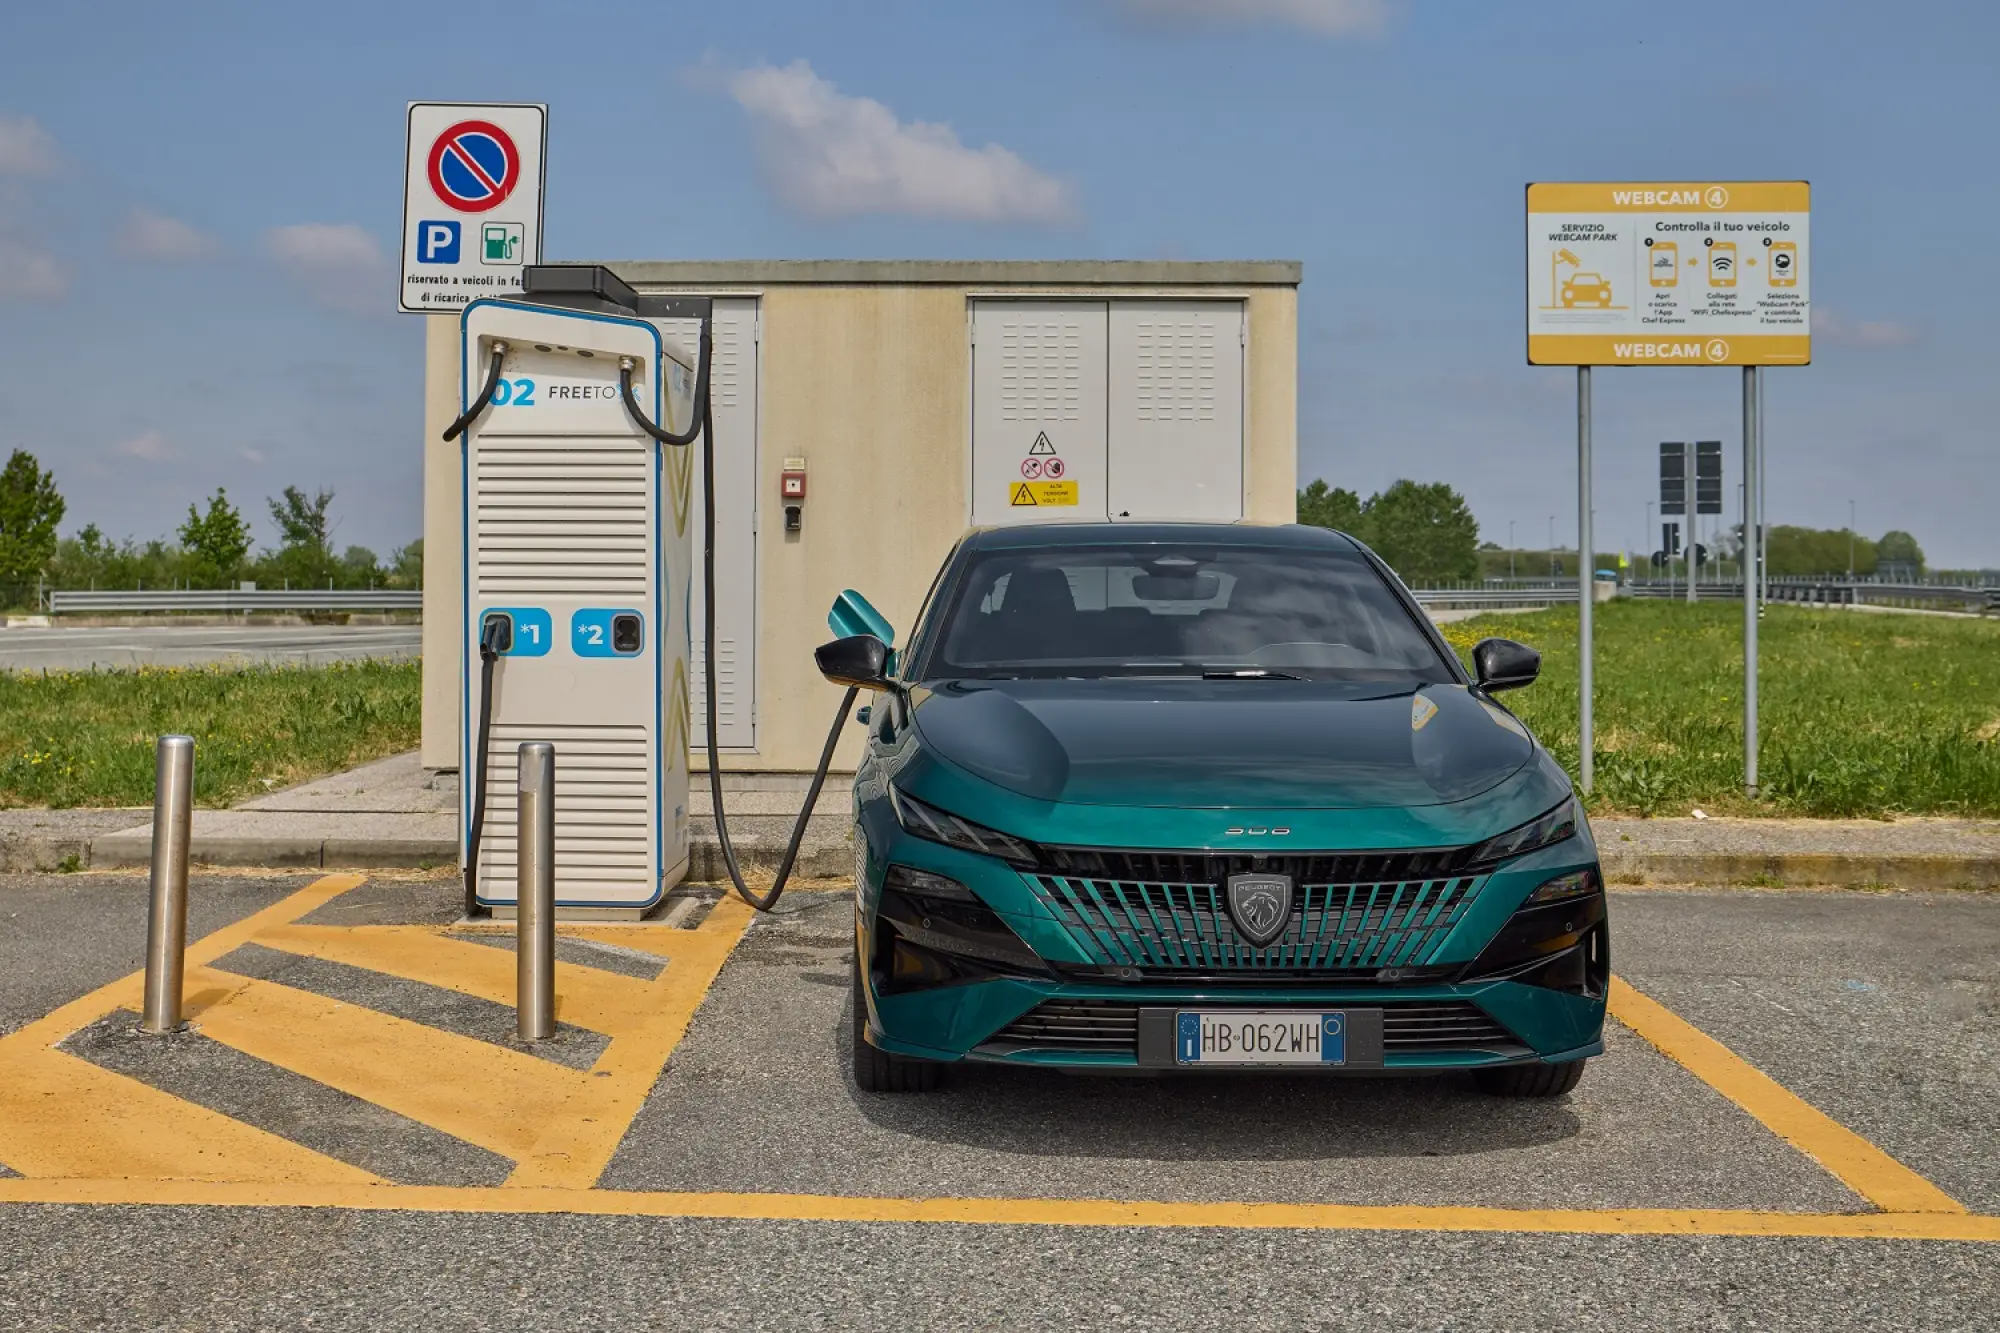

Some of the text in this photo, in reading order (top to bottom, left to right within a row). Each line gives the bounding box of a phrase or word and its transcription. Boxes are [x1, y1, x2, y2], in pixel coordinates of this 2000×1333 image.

[1612, 191, 1722, 205] WEBCAM 4
[1561, 224, 1605, 232] SERVIZIO
[1655, 221, 1790, 232] Controlla il tuo veicolo
[426, 226, 453, 259] P
[1548, 233, 1618, 241] WEBCAM PARK
[407, 274, 449, 284] riservato
[453, 277, 458, 285] a
[462, 276, 493, 286] veicoli
[498, 276, 506, 286] in
[421, 292, 430, 302] di
[434, 293, 470, 303] ricarica
[1613, 343, 1723, 358] WEBCAM 4
[490, 377, 535, 406] 02
